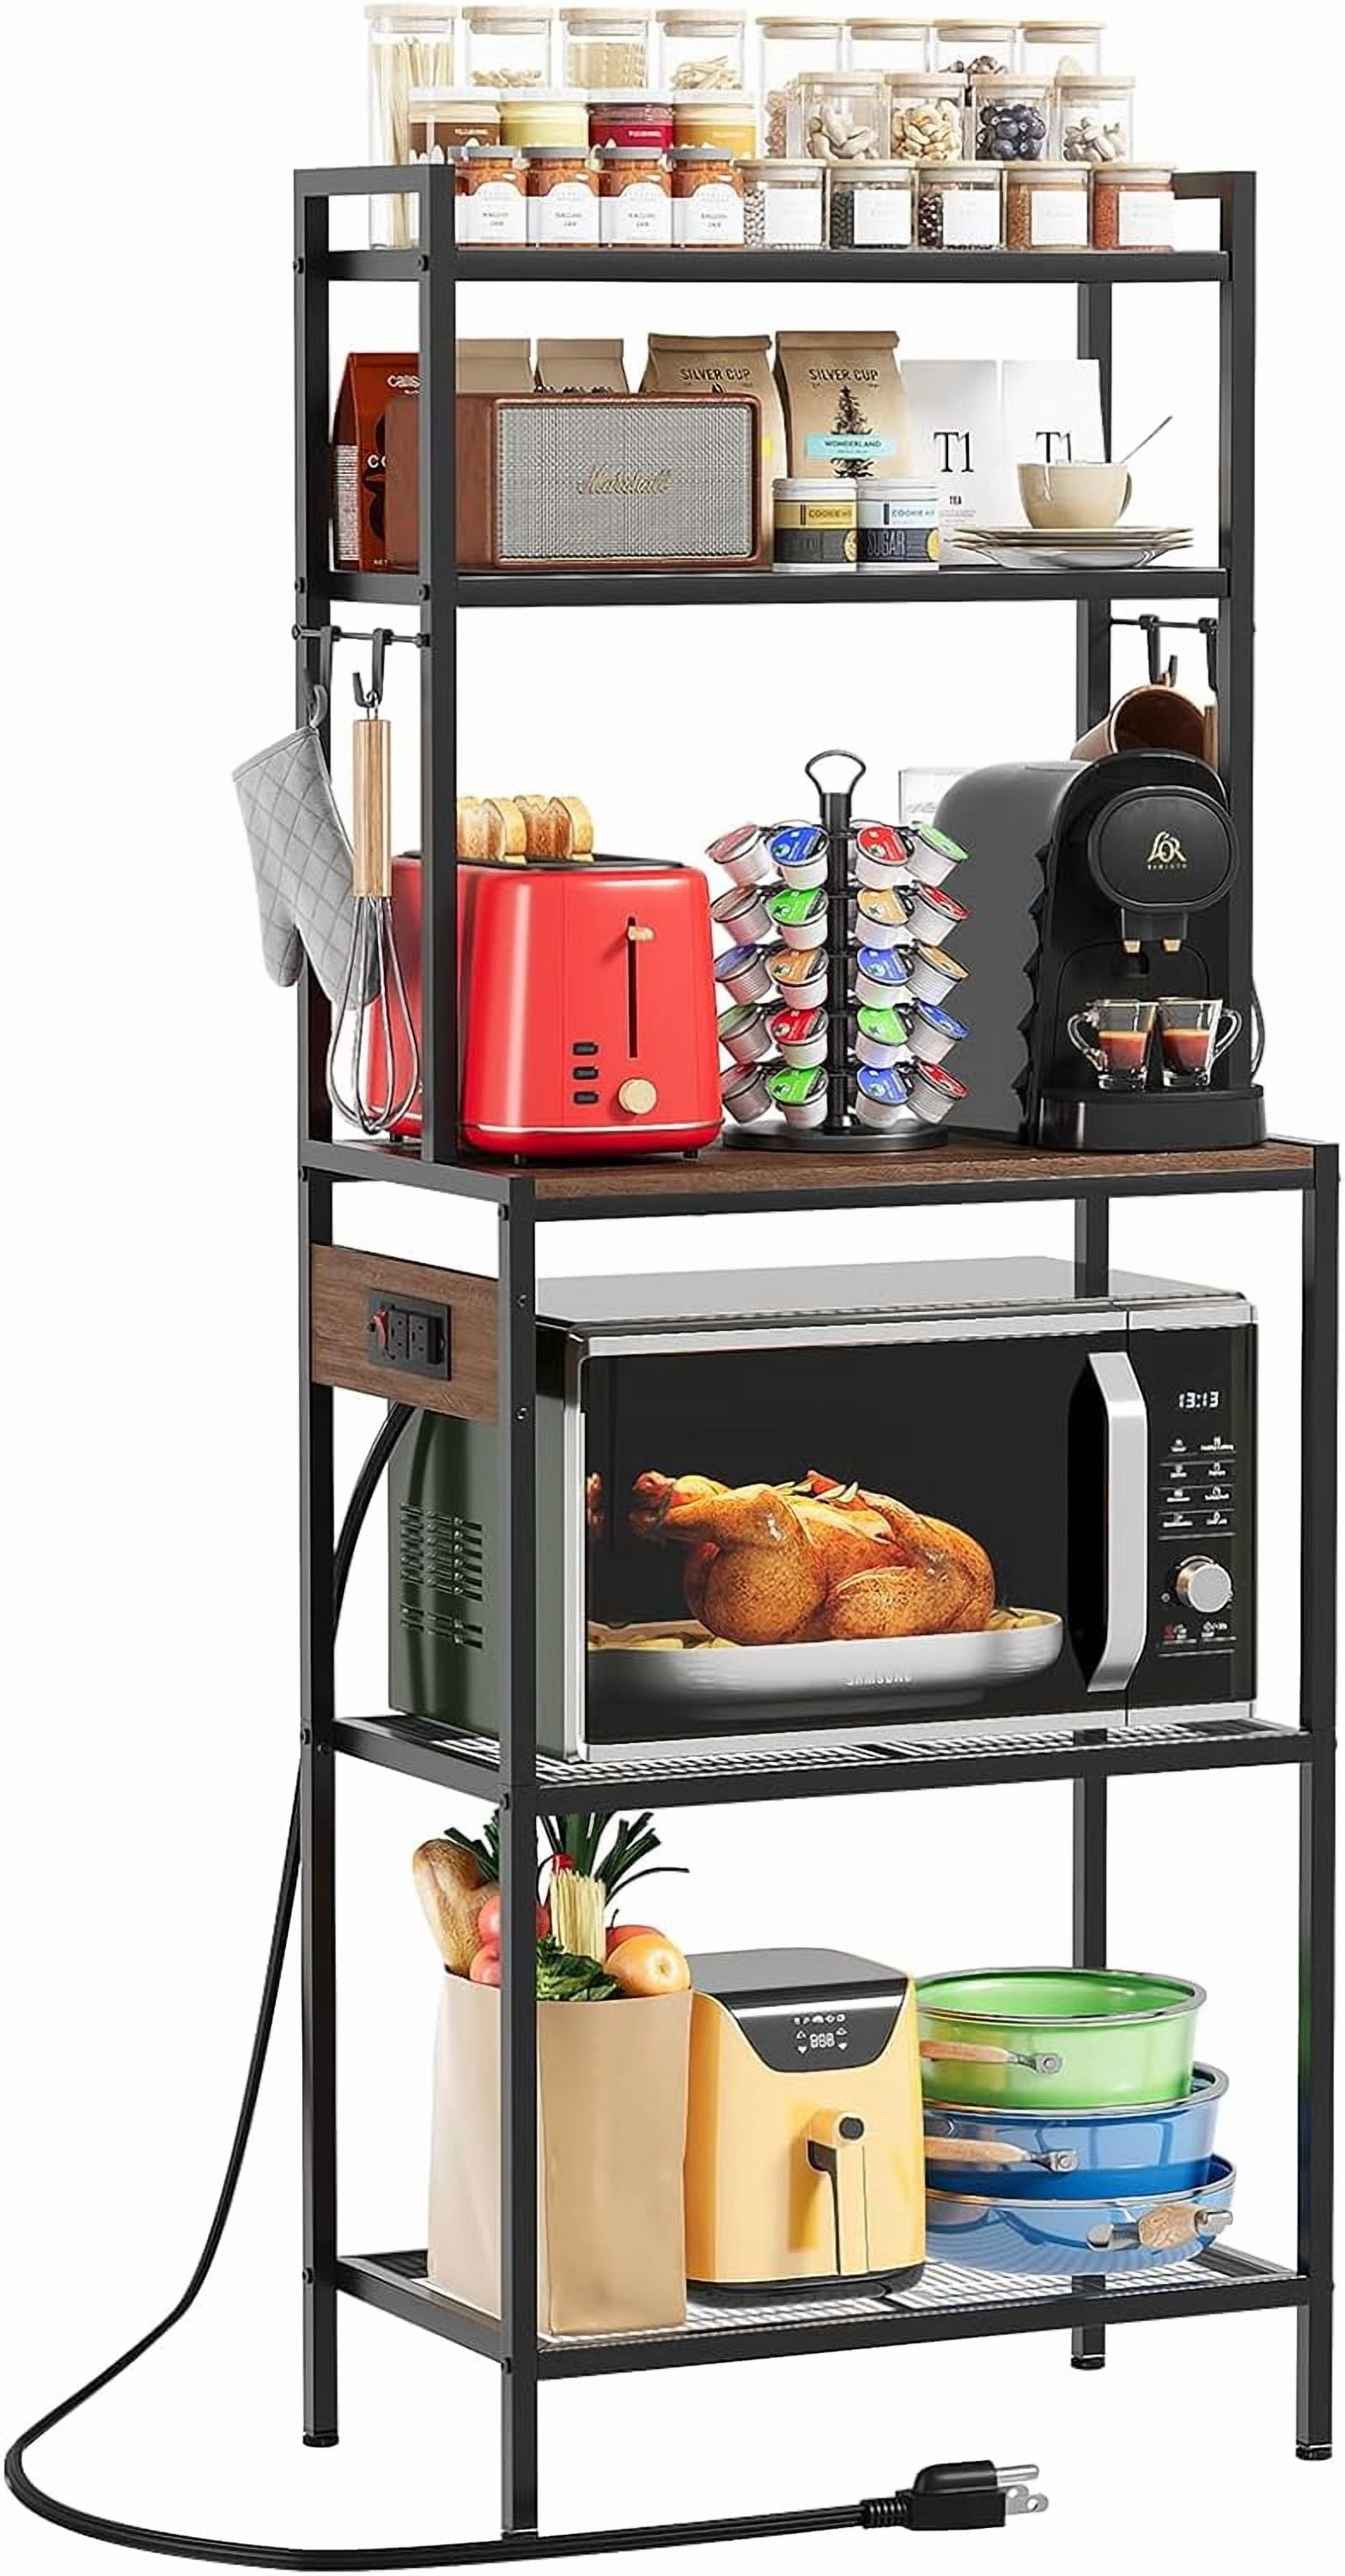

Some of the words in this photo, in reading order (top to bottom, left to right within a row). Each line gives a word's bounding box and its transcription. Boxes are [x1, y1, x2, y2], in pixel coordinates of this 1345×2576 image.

[680, 368, 723, 380] SILVER
[725, 368, 751, 380] CUP
[808, 368, 851, 380] SILVER
[853, 368, 879, 380] CUP
[933, 431, 975, 472] T1
[1035, 431, 1073, 464] T1
[867, 531, 906, 556] SUGAR
[1178, 1391, 1220, 1409] 13:13
